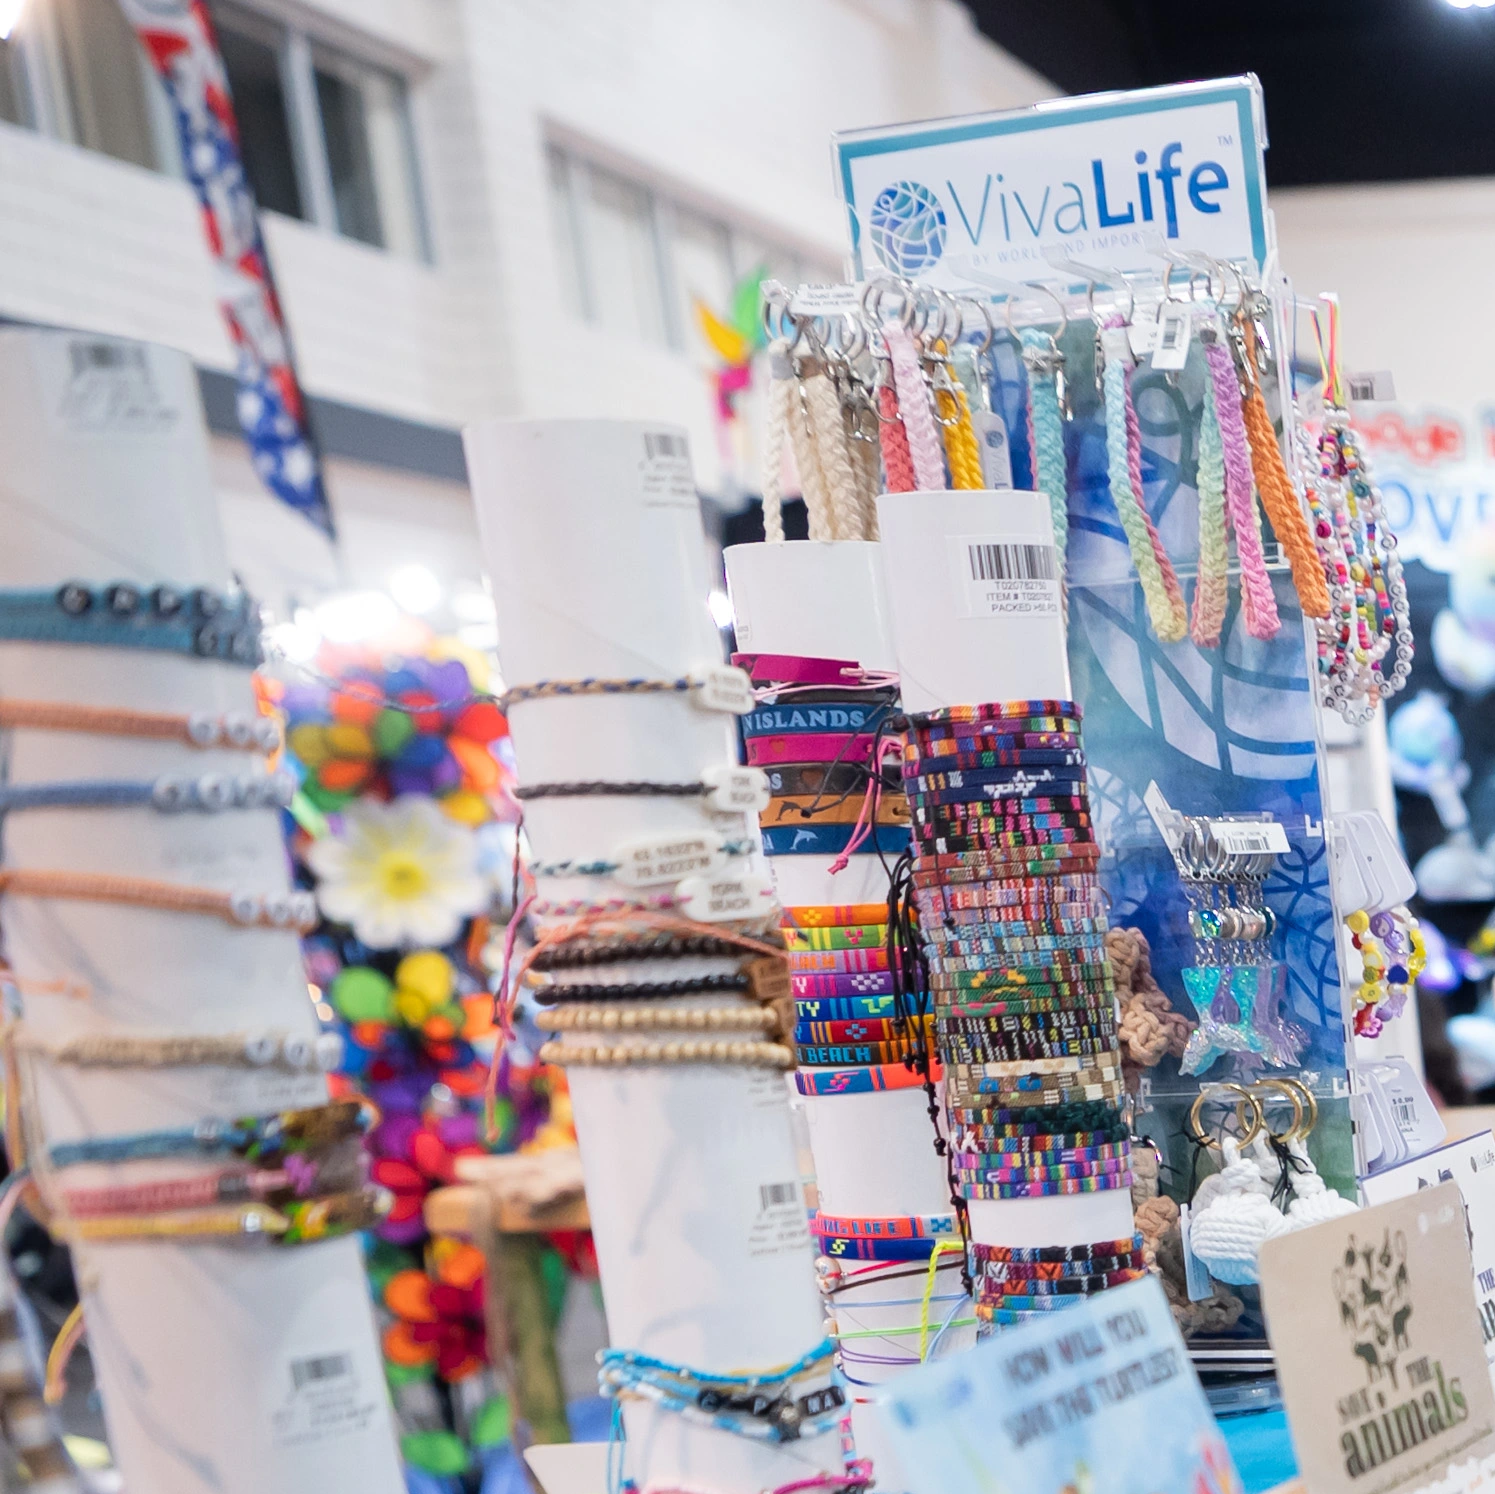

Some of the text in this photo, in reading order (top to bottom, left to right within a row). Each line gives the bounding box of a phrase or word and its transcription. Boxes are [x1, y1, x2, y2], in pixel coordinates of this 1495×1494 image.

[946, 141, 1230, 246] VivaLife
[998, 244, 1049, 263] WORL
[991, 603, 1032, 612] PACKED
[755, 710, 866, 730] ISLANDS
[807, 1047, 872, 1063] BEACH
[1339, 1361, 1469, 1480] animals
